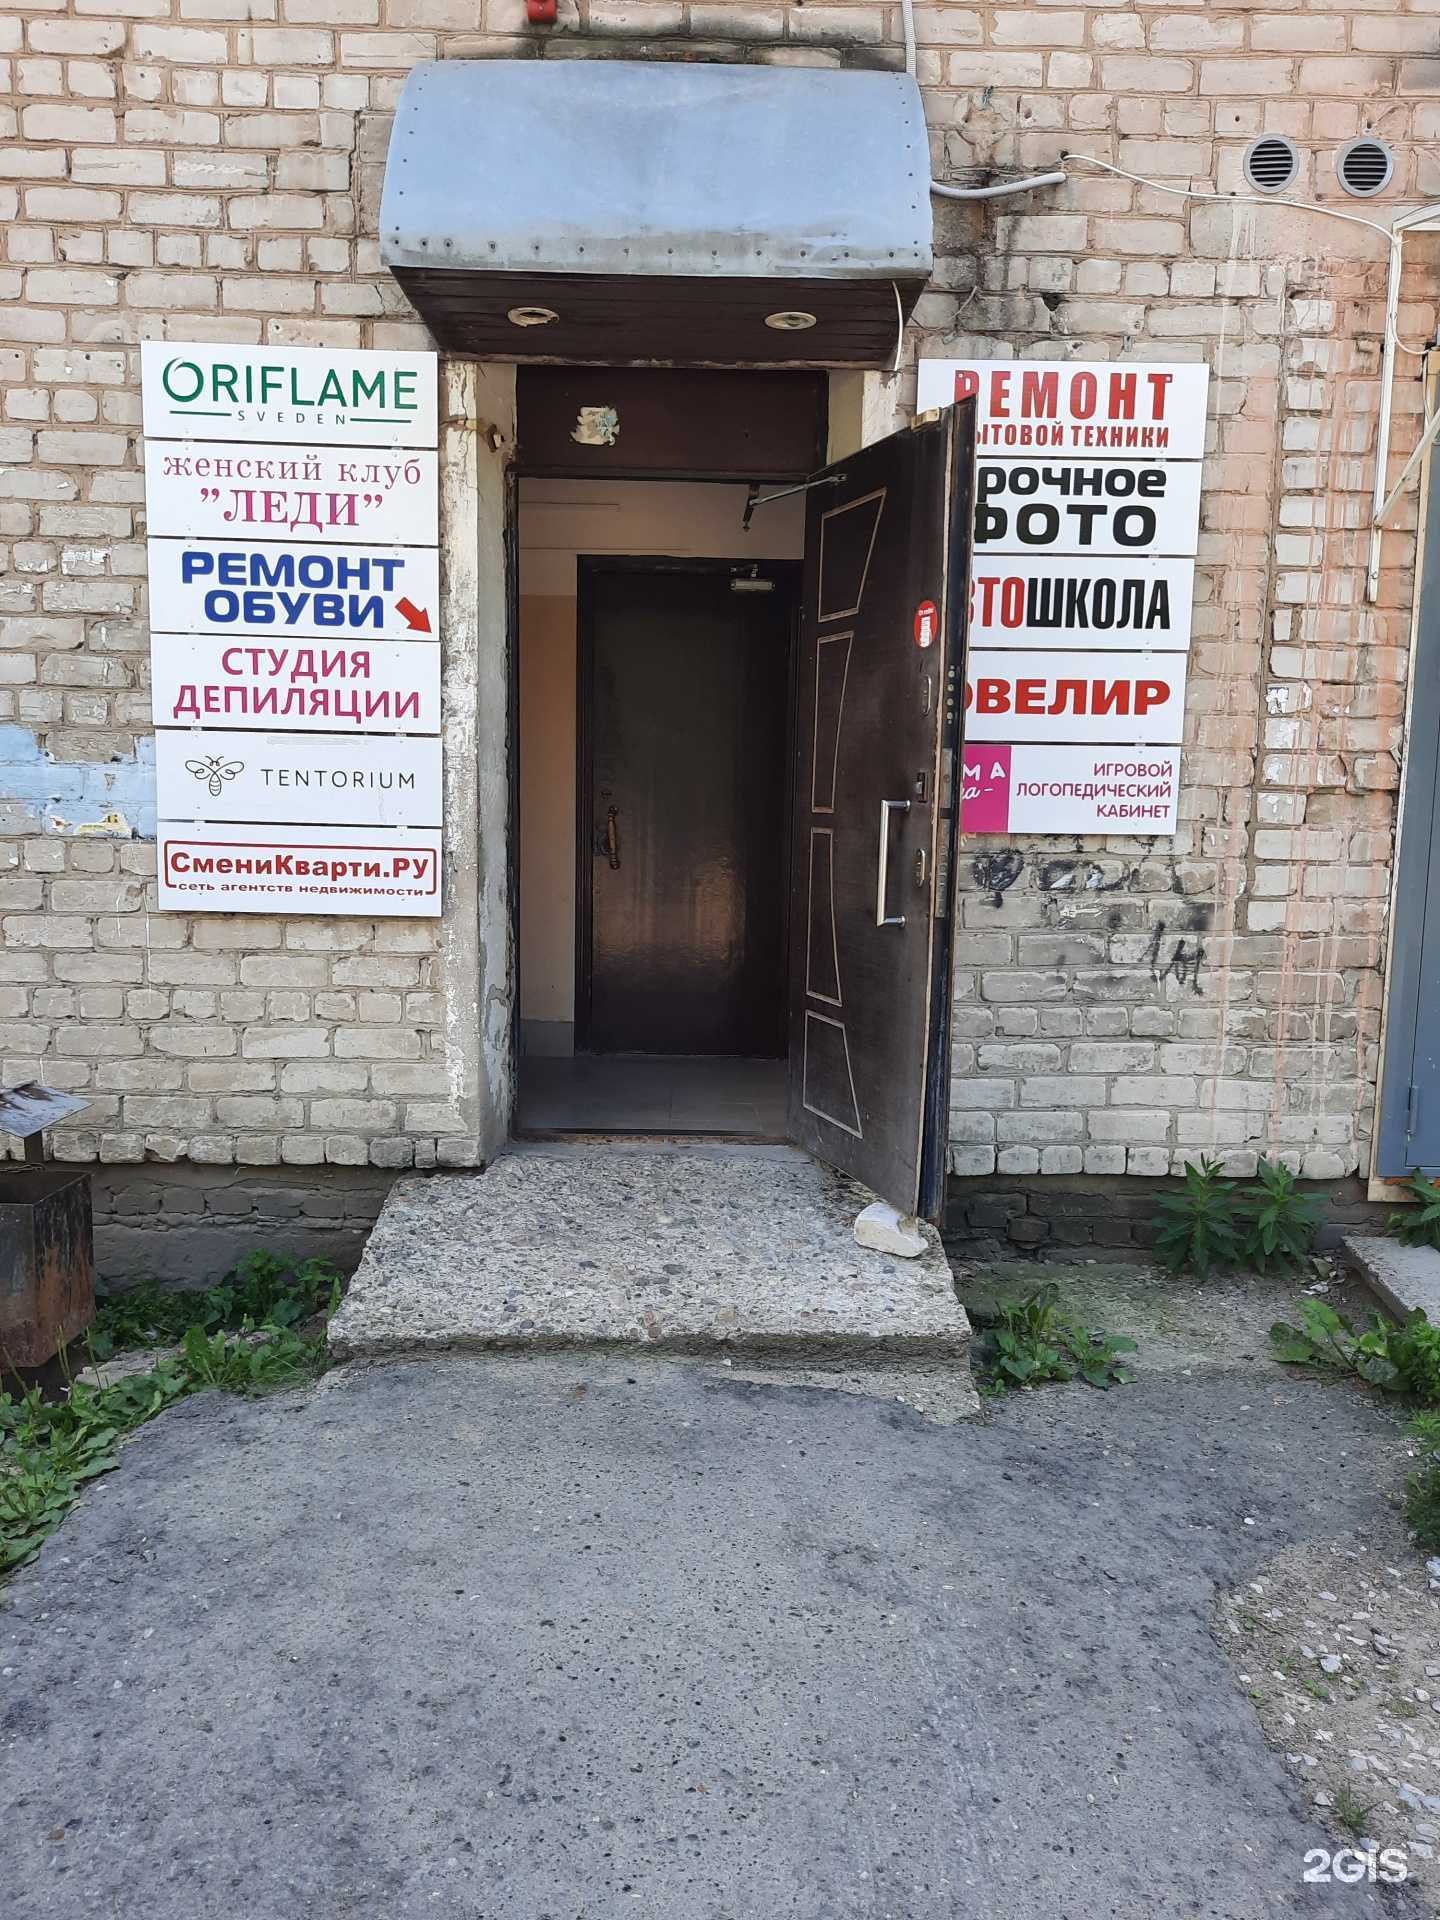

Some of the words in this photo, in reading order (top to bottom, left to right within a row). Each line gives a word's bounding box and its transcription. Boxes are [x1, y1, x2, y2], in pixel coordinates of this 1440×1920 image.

[162, 357, 418, 410] ORIFLAME
[953, 369, 1173, 420] РЕМОНТ
[237, 410, 346, 424] SVEDEN
[1071, 424, 1169, 448] ТЕХНИКИ
[163, 454, 322, 481] женский
[338, 457, 421, 490] клуб
[977, 466, 1167, 503] рочное
[181, 551, 405, 591] РЕМОНТ
[204, 589, 384, 628] ОБУВИ
[221, 647, 370, 684] СТУДИЯ
[172, 685, 420, 724] ДЕПИЛЯЦИИ
[964, 678, 1171, 716] ВЕЛИР
[260, 768, 415, 789] TENTORIUM
[1093, 761, 1173, 777] ИГРОВОЙ
[1016, 779, 1172, 799] ЛОГОПЕДИЧЕСКИЙ
[1096, 804, 1171, 818] КАБИНЕТ
[178, 882, 215, 891] сеть
[221, 883, 292, 893] агентств
[299, 885, 425, 896] недвижимости
